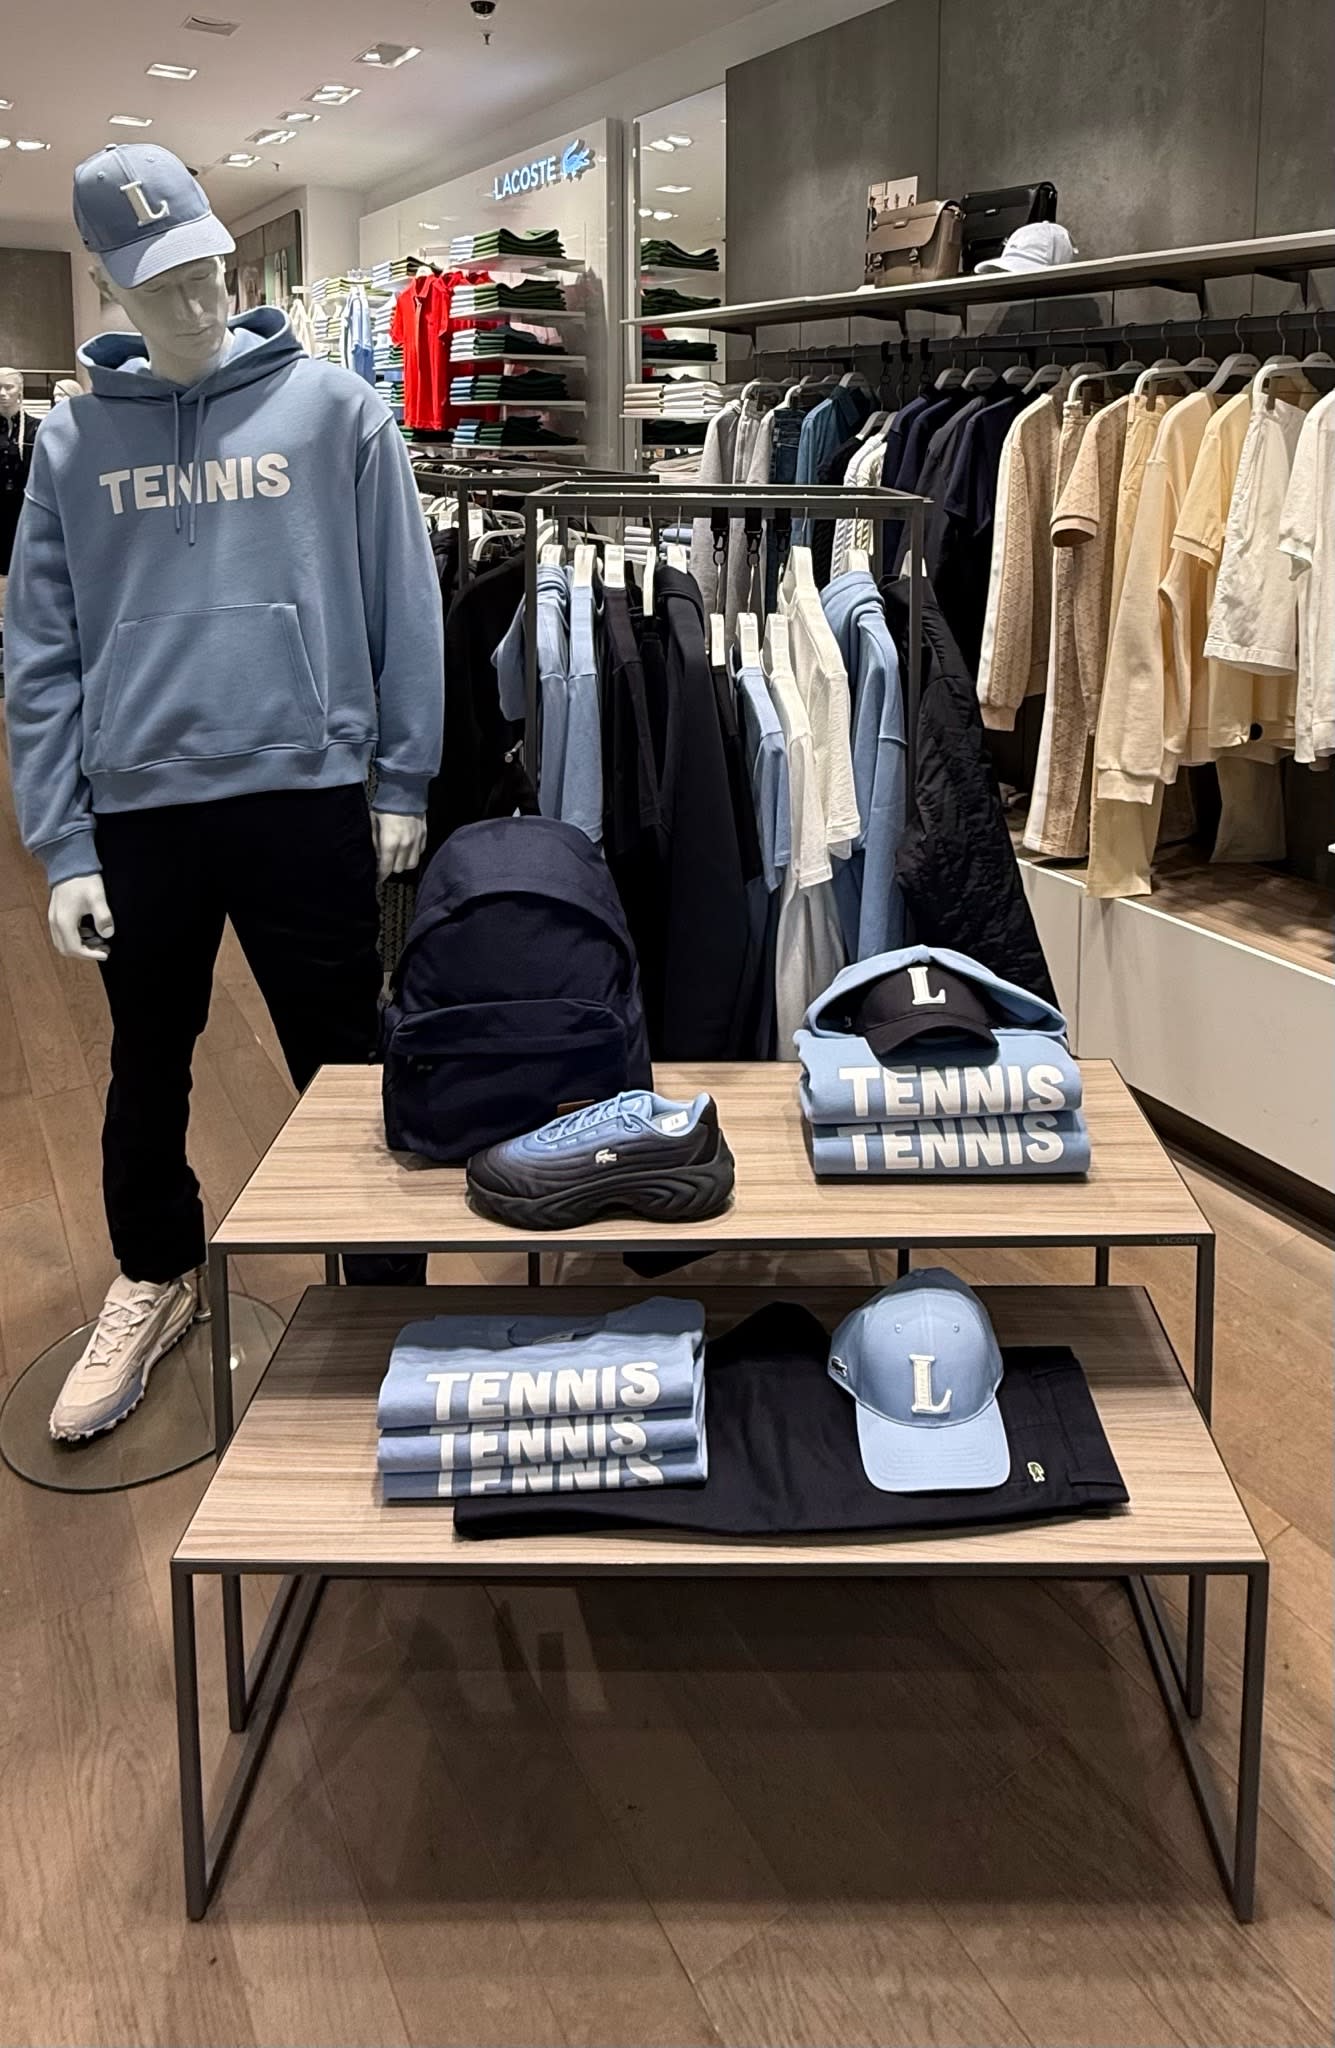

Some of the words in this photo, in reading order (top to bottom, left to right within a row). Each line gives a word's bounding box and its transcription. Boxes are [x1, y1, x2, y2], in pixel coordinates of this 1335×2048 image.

[120, 181, 170, 227] L
[493, 156, 557, 200] LACOSTE
[99, 453, 291, 514] TENNIS
[907, 966, 946, 1006] L
[838, 1064, 1066, 1117] TENNIS
[837, 1113, 1065, 1171] TENNIS
[426, 1361, 661, 1421] TENNIS
[909, 1354, 952, 1414] L
[429, 1412, 647, 1471] TENNIS
